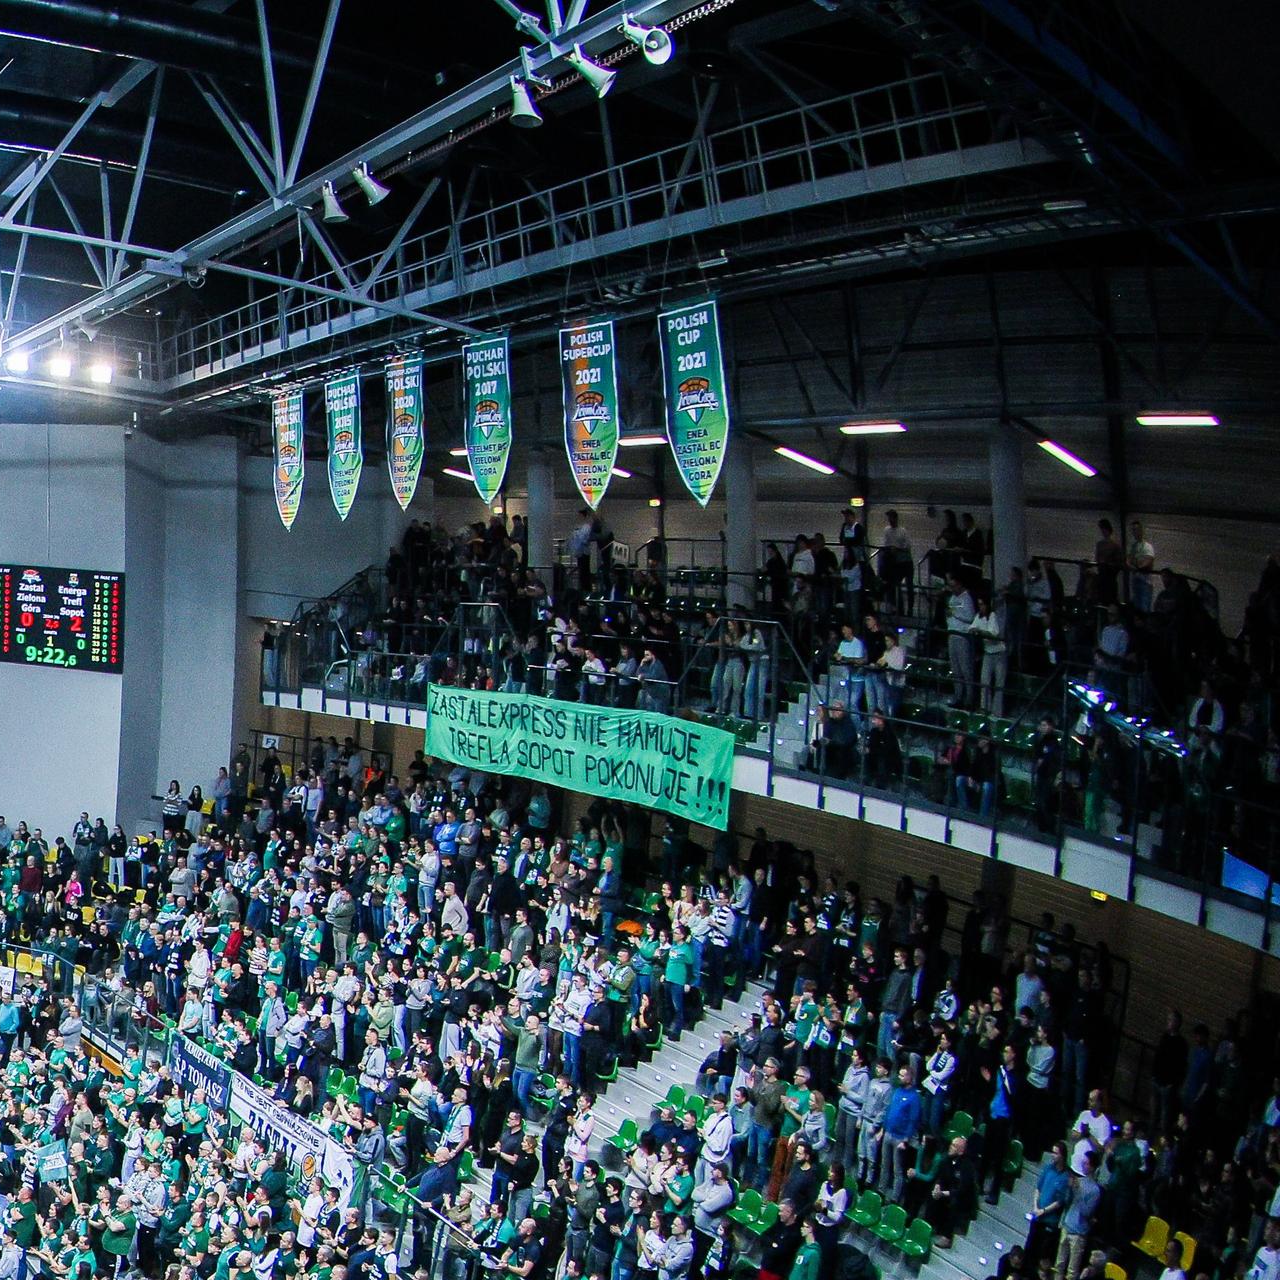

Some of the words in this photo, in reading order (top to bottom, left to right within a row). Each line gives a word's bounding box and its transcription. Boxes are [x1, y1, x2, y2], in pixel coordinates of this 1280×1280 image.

[667, 311, 708, 332] POLISH
[570, 331, 602, 346] POLISH
[677, 329, 700, 346] CUP
[467, 348, 504, 364] PUCHAR
[563, 344, 611, 360] SUPERCUP
[677, 351, 707, 372] 2021
[467, 364, 505, 379] POLSKI
[575, 368, 601, 385] 2021
[388, 376, 419, 392] POLSKI
[475, 380, 497, 396] 2017
[687, 429, 708, 439] ENEA
[677, 442, 708, 454] ZASTAL
[710, 440, 720, 450] BC
[682, 456, 717, 468] ZIELONA
[19, 583, 44, 592] Zastal
[58, 586, 87, 596] Energa
[17, 593, 46, 603] Zielona
[62, 597, 82, 606] Trefl
[21, 603, 41, 613] Góra
[60, 607, 85, 617] Sopot
[21, 612, 34, 627] 0
[70, 616, 82, 632] 2
[16, 634, 25, 644] 0
[47, 636, 54, 647] 1
[77, 639, 86, 650] 0
[25, 646, 77, 667] 9:22,6
[430, 691, 566, 739] ZASTALEXPRESS
[574, 714, 609, 746] NIE
[618, 723, 702, 767] HAMUJE
[449, 727, 510, 765] TREFLA
[517, 739, 574, 778] SOPOT
[586, 755, 690, 806] POKONUJE
[190, 1064, 222, 1103] TOMASZ
